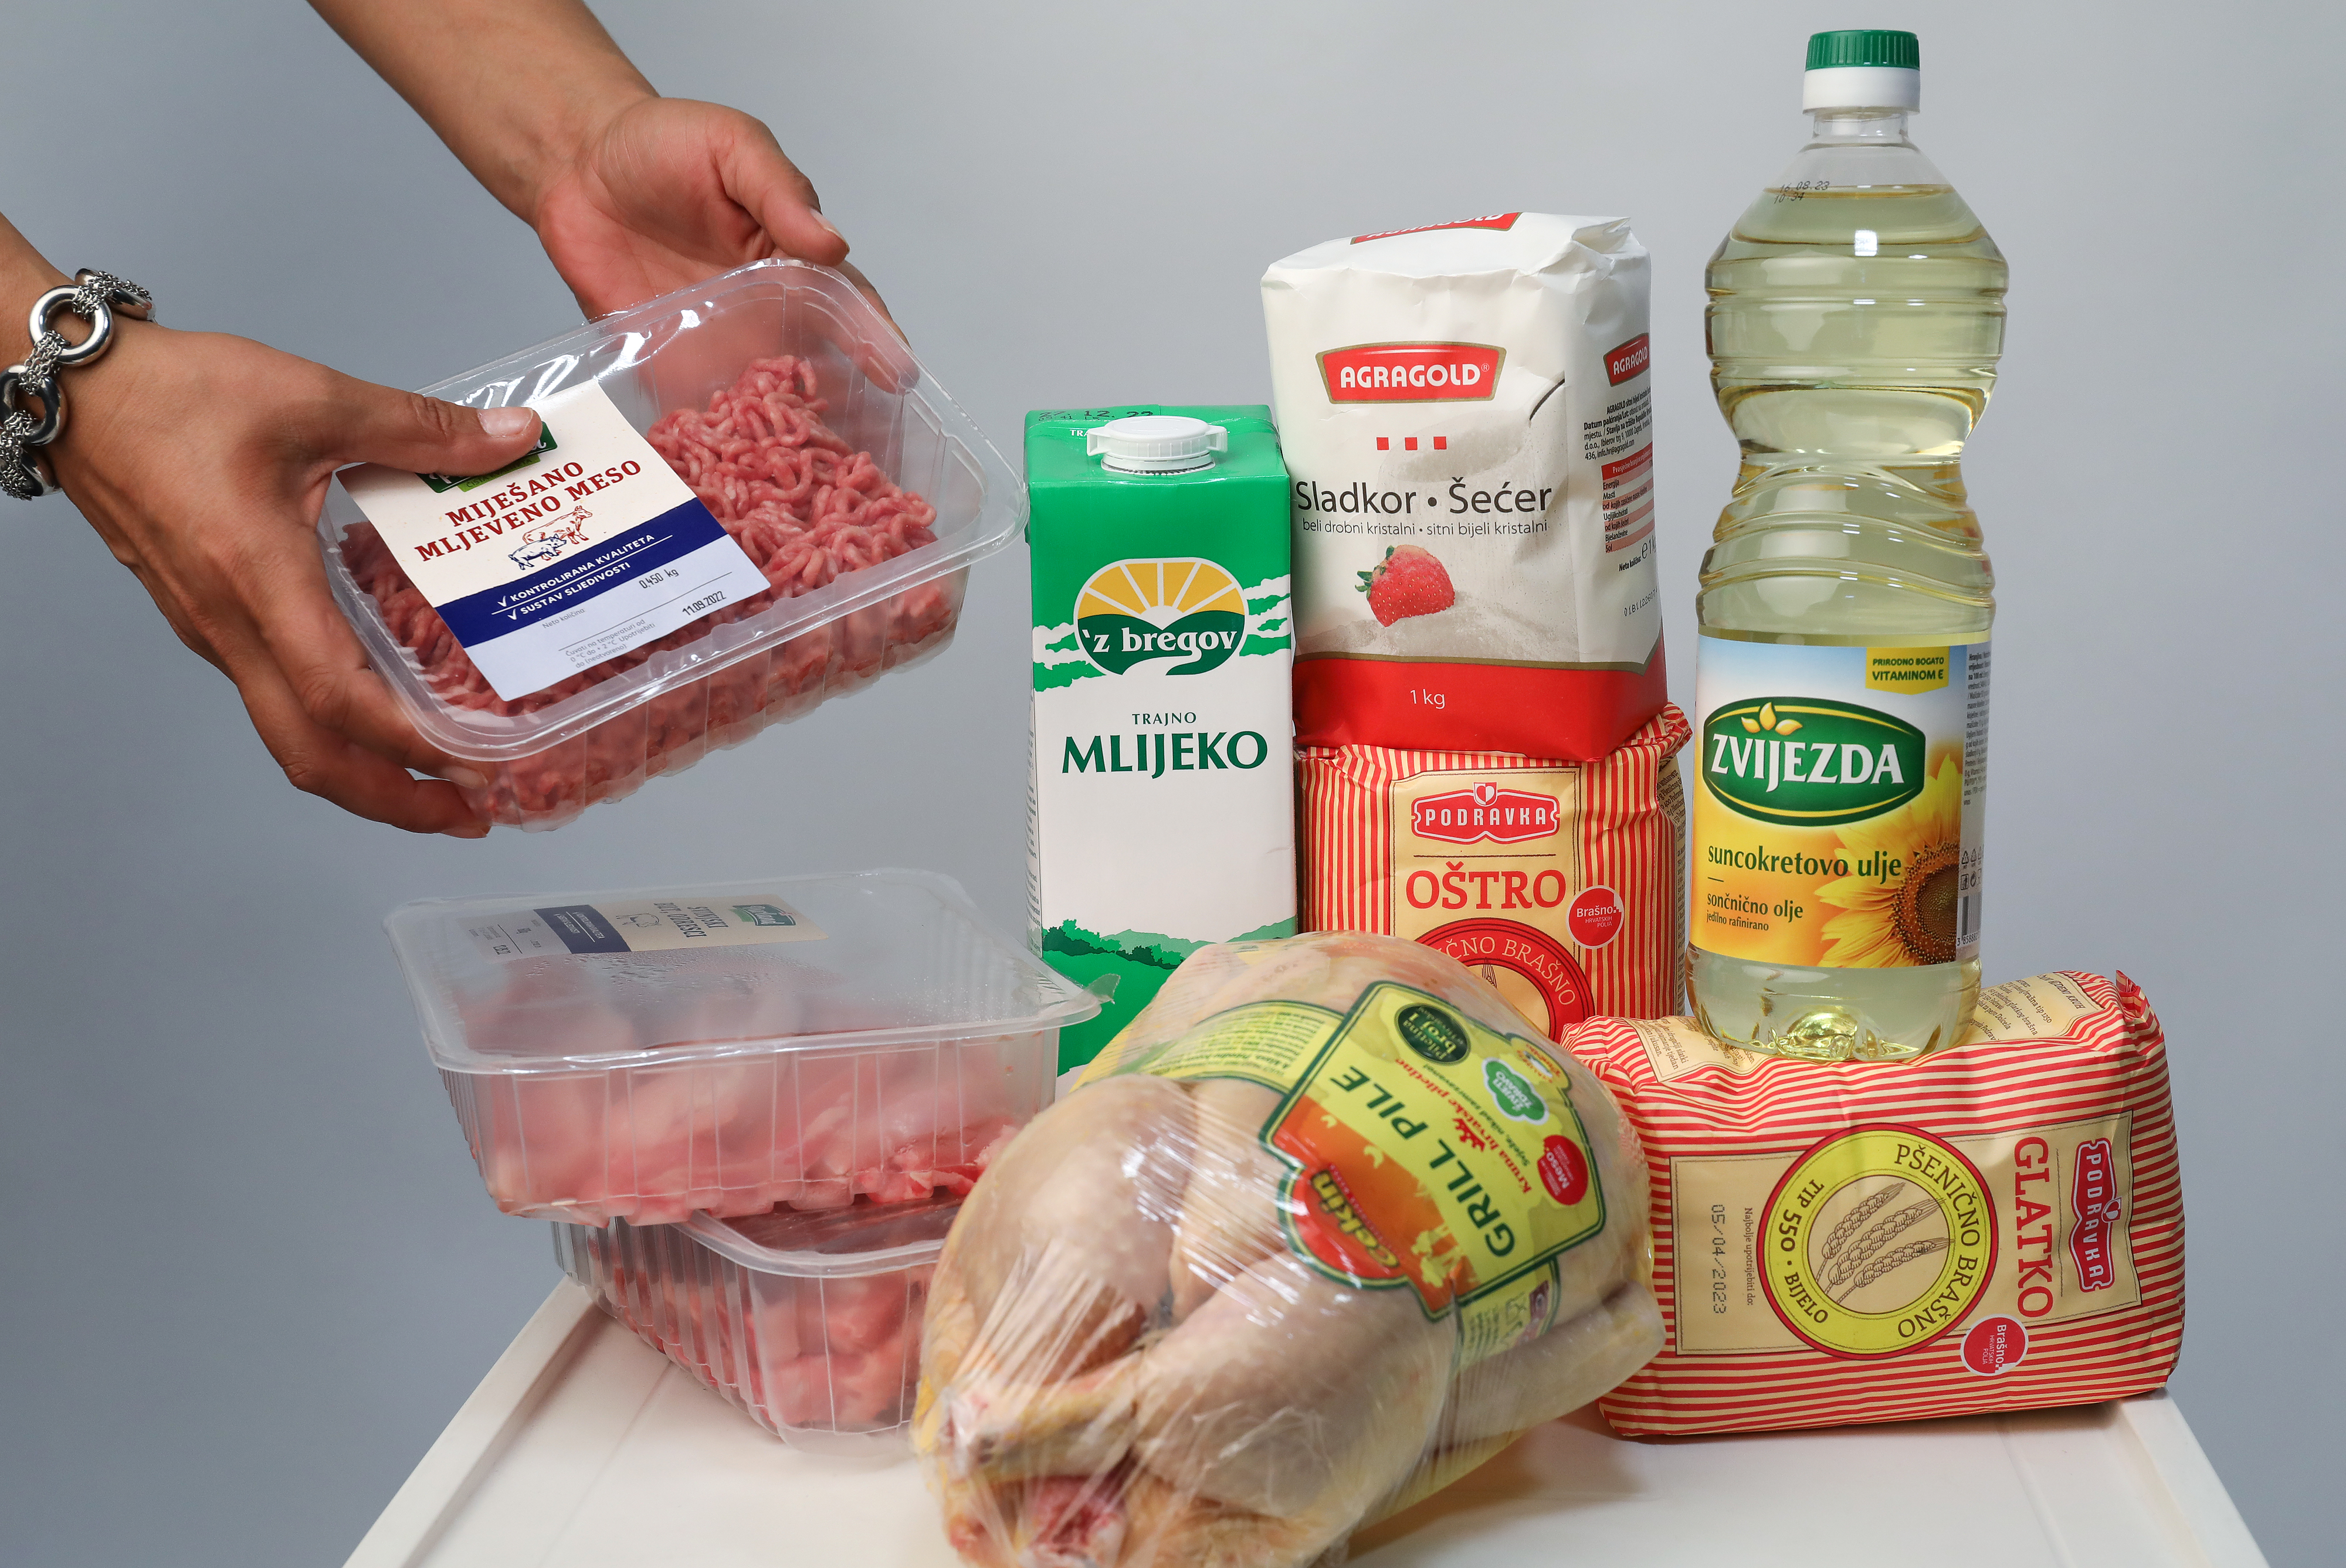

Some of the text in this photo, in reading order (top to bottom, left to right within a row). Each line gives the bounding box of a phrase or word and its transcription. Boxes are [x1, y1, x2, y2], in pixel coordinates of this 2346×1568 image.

[1613, 345, 1648, 376] AGRAGOLD
[1584, 420, 1603, 431] Datum
[1584, 432, 1603, 442] mjestu.
[1606, 425, 1621, 436] Stavlja
[1600, 436, 1616, 446] Iblerov
[1585, 450, 1597, 461] 436,
[445, 461, 584, 527] MIJEŠANO
[1295, 476, 1552, 514] Sladkor Šećer
[1602, 480, 1620, 490] Energija
[1602, 491, 1616, 500] Masti
[413, 460, 642, 562] MLJEVENO MESO
[1602, 502, 1610, 510] od
[1610, 498, 1621, 509] kojih
[1603, 507, 1629, 521] Ugljikohidrati
[1302, 517, 1548, 538] beli drobni kristalni sitni bijeli kristalni
[1604, 523, 1612, 531] od
[1611, 520, 1621, 531] kojih
[1605, 530, 1628, 542] Bjelančevine
[1605, 544, 1613, 553] Sol
[509, 534, 656, 602] KONTROLIRANA KVALITETA
[638, 567, 680, 590] 0,450 kg
[1619, 563, 1630, 572] Neto
[520, 561, 632, 615] SUSTAV SLJEDIVOSTI
[682, 590, 727, 617] 11.09.2022
[541, 618, 560, 629] Neto
[565, 644, 588, 657] Čuvati
[596, 623, 636, 644] temperaturi
[636, 619, 646, 627] od
[586, 647, 596, 656] do
[618, 622, 656, 643] Upotrijebiti
[1120, 627, 1238, 667] bregov
[575, 643, 628, 669] do (neotvoreno)
[1872, 656, 1945, 666] PRIRODNO BOGATO
[1872, 668, 1944, 681] VITAMINOM E
[1409, 687, 1446, 710] 1 kg
[1131, 711, 1198, 727] TRAJNO
[1062, 730, 1268, 779] MLIJEKO
[1710, 732, 1905, 793] ZVIJEZDA
[1425, 806, 1548, 827] PODRAVKA
[1707, 844, 1903, 884] suncokretovo ulje
[1405, 860, 1568, 911] OŠTRO
[1585, 915, 1613, 924] HRVATSKIH
[1706, 891, 1803, 924] sončnično olje
[1706, 909, 1769, 932] jedilno rafinirano
[1501, 938, 1577, 1007] BRAŠNO
[2023, 990, 2053, 1024] brašna tip 1250
[2066, 995, 2086, 1010] KRUH
[1994, 1013, 2012, 1030] Dolcela
[2009, 1002, 2025, 1019] glatkog
[2022, 1016, 2039, 1036] brašna
[1402, 1020, 1447, 1060] Piletina
[1419, 1020, 1457, 1054] broj
[1650, 1037, 1662, 1057] ukusan.
[1665, 1051, 1679, 1070] tjedan
[1676, 1048, 1689, 1064] slatki
[1330, 1066, 1430, 1141] PILE
[1395, 1057, 1533, 1194] Kruna hrvatske piletine
[1479, 1109, 1506, 1136] nikad
[1429, 1140, 1516, 1258] GRILL
[1778, 1179, 1825, 1253] TIP 550
[2013, 1135, 2054, 1319] GLATKO
[2082, 1155, 2105, 1279] PODRAVKA
[1894, 1143, 1981, 1339] PŠENIČNO BRAŠNO
[1711, 1204, 1727, 1314] 05/04/2023
[1742, 1207, 1756, 1306] Najbolje upotrijebiti do:
[1784, 1271, 1829, 1324] BIJELO
